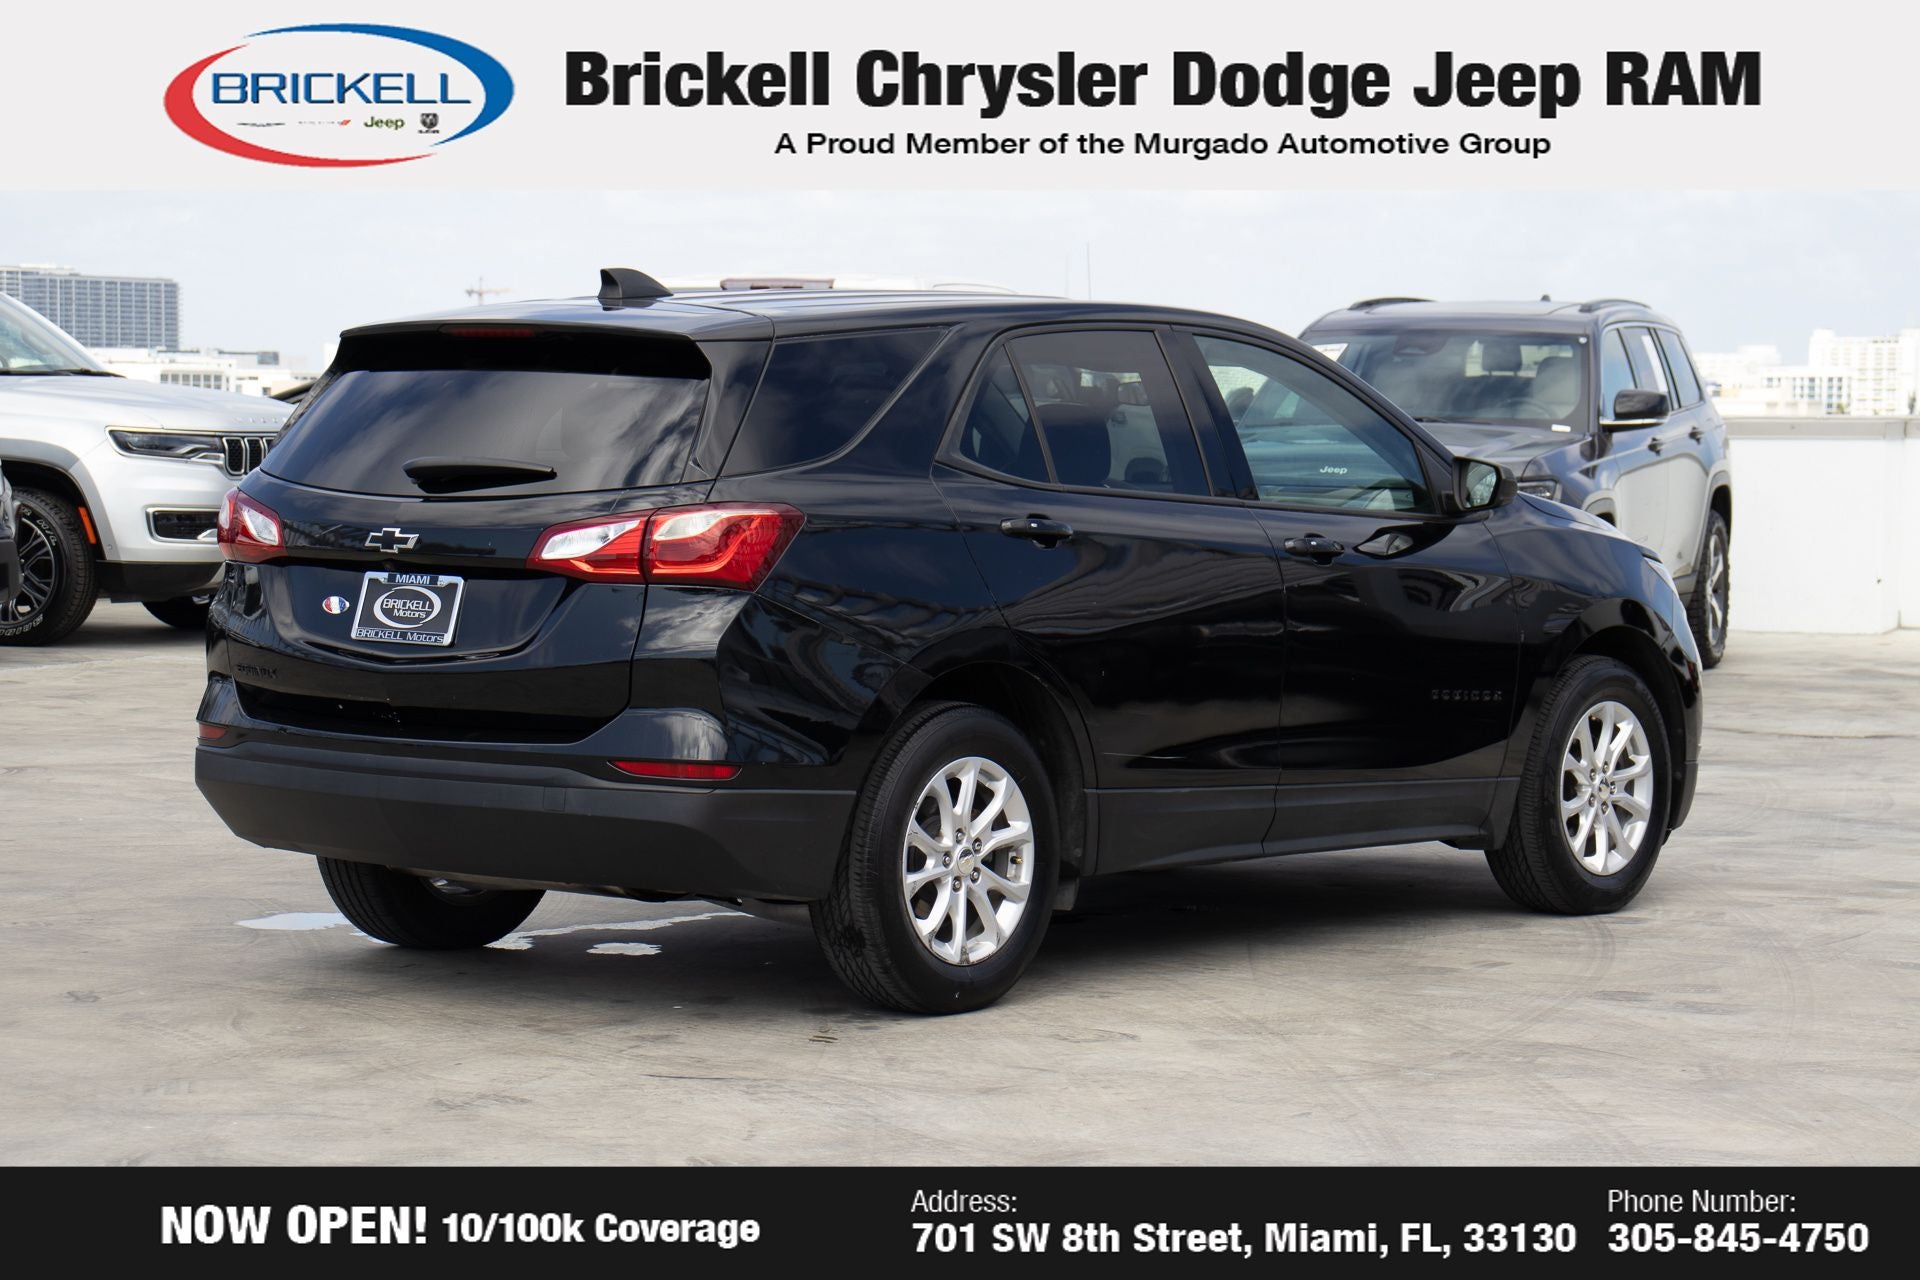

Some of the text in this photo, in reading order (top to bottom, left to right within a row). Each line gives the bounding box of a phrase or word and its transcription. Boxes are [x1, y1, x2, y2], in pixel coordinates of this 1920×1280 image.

[1319, 465, 1348, 475] Jeep
[395, 573, 431, 585] MIAMI
[382, 598, 432, 612] BRICKELL
[393, 609, 426, 619] Motors
[356, 628, 403, 641] BRICKELL
[406, 632, 444, 644] Motors
